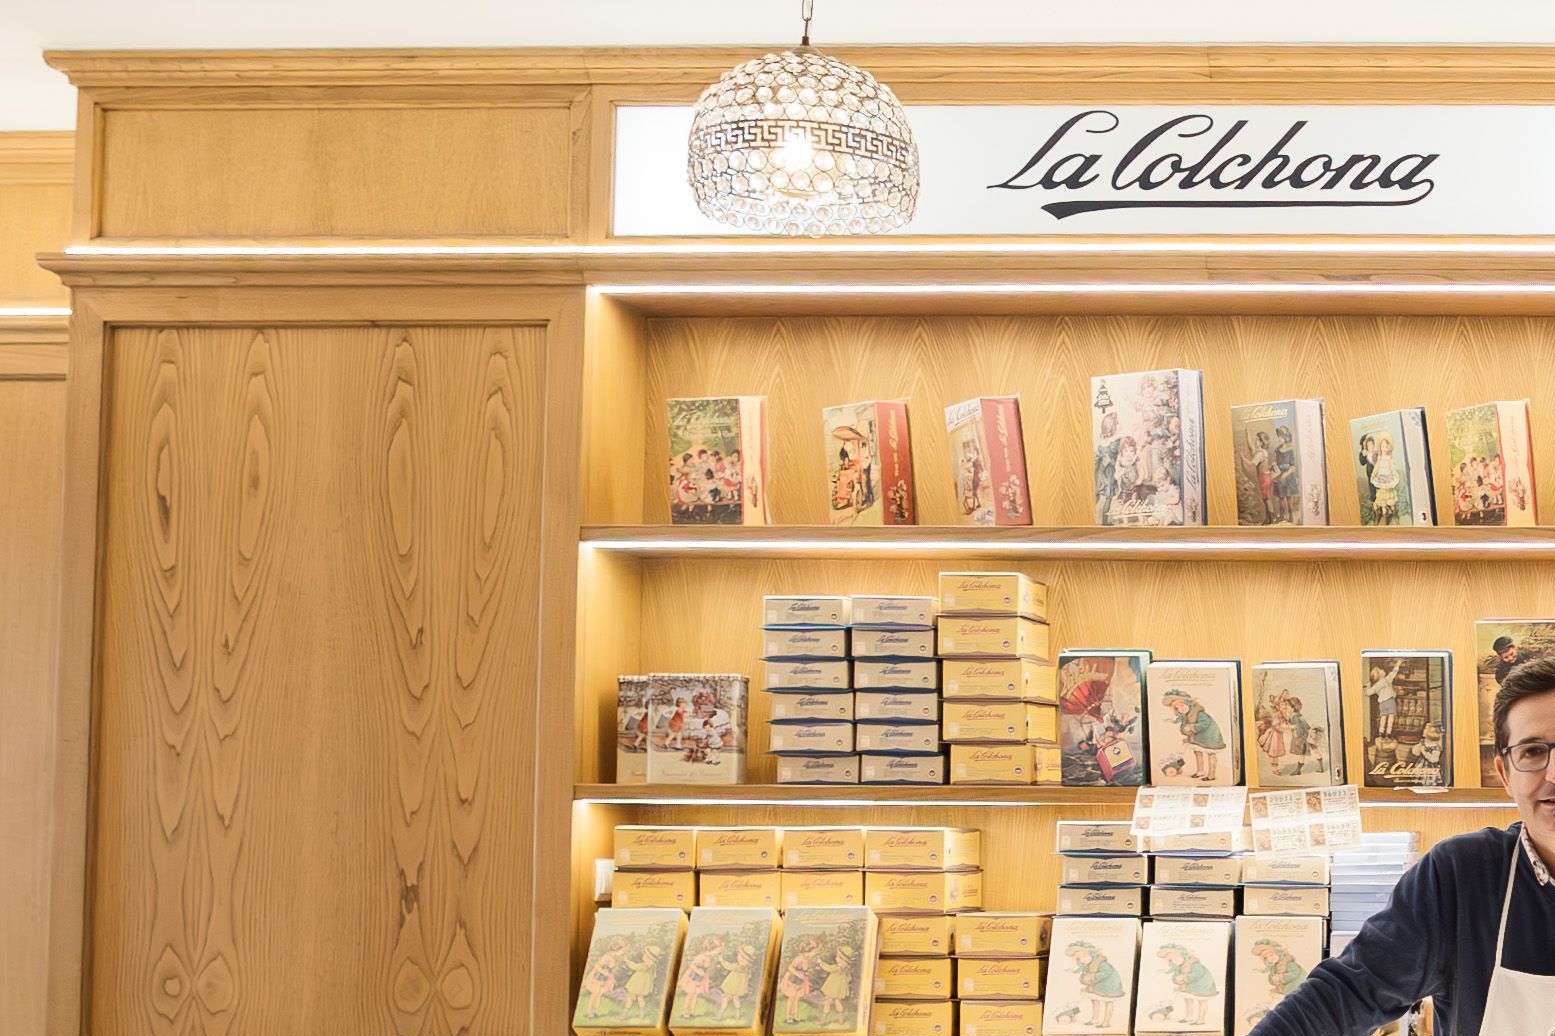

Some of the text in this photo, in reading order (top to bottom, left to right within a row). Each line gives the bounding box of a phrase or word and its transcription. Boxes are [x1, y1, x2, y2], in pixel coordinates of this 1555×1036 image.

[987, 110, 1441, 205] La Colchona
[1368, 762, 1388, 774] La
